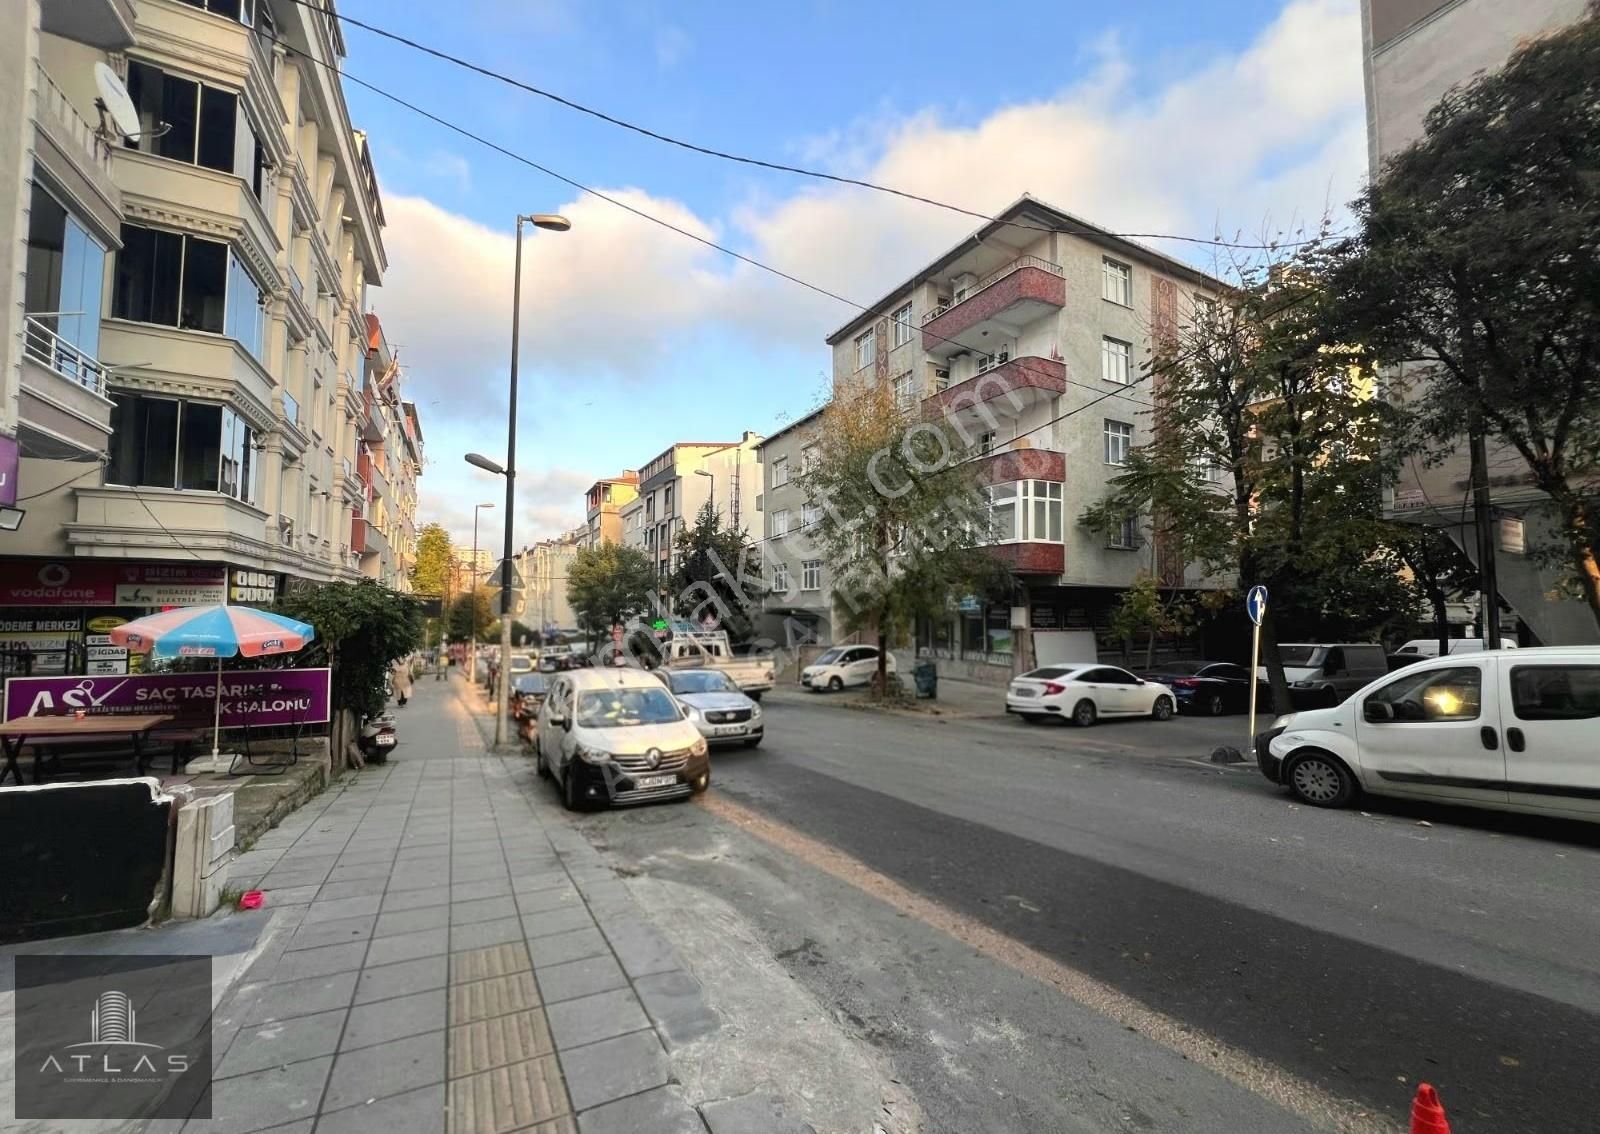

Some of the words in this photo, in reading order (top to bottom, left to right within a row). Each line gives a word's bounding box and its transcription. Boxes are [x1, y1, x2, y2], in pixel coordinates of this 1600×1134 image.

[10, 587, 95, 598] vodafone
[136, 687, 178, 702] SAÇ
[236, 698, 311, 714] SALONU
